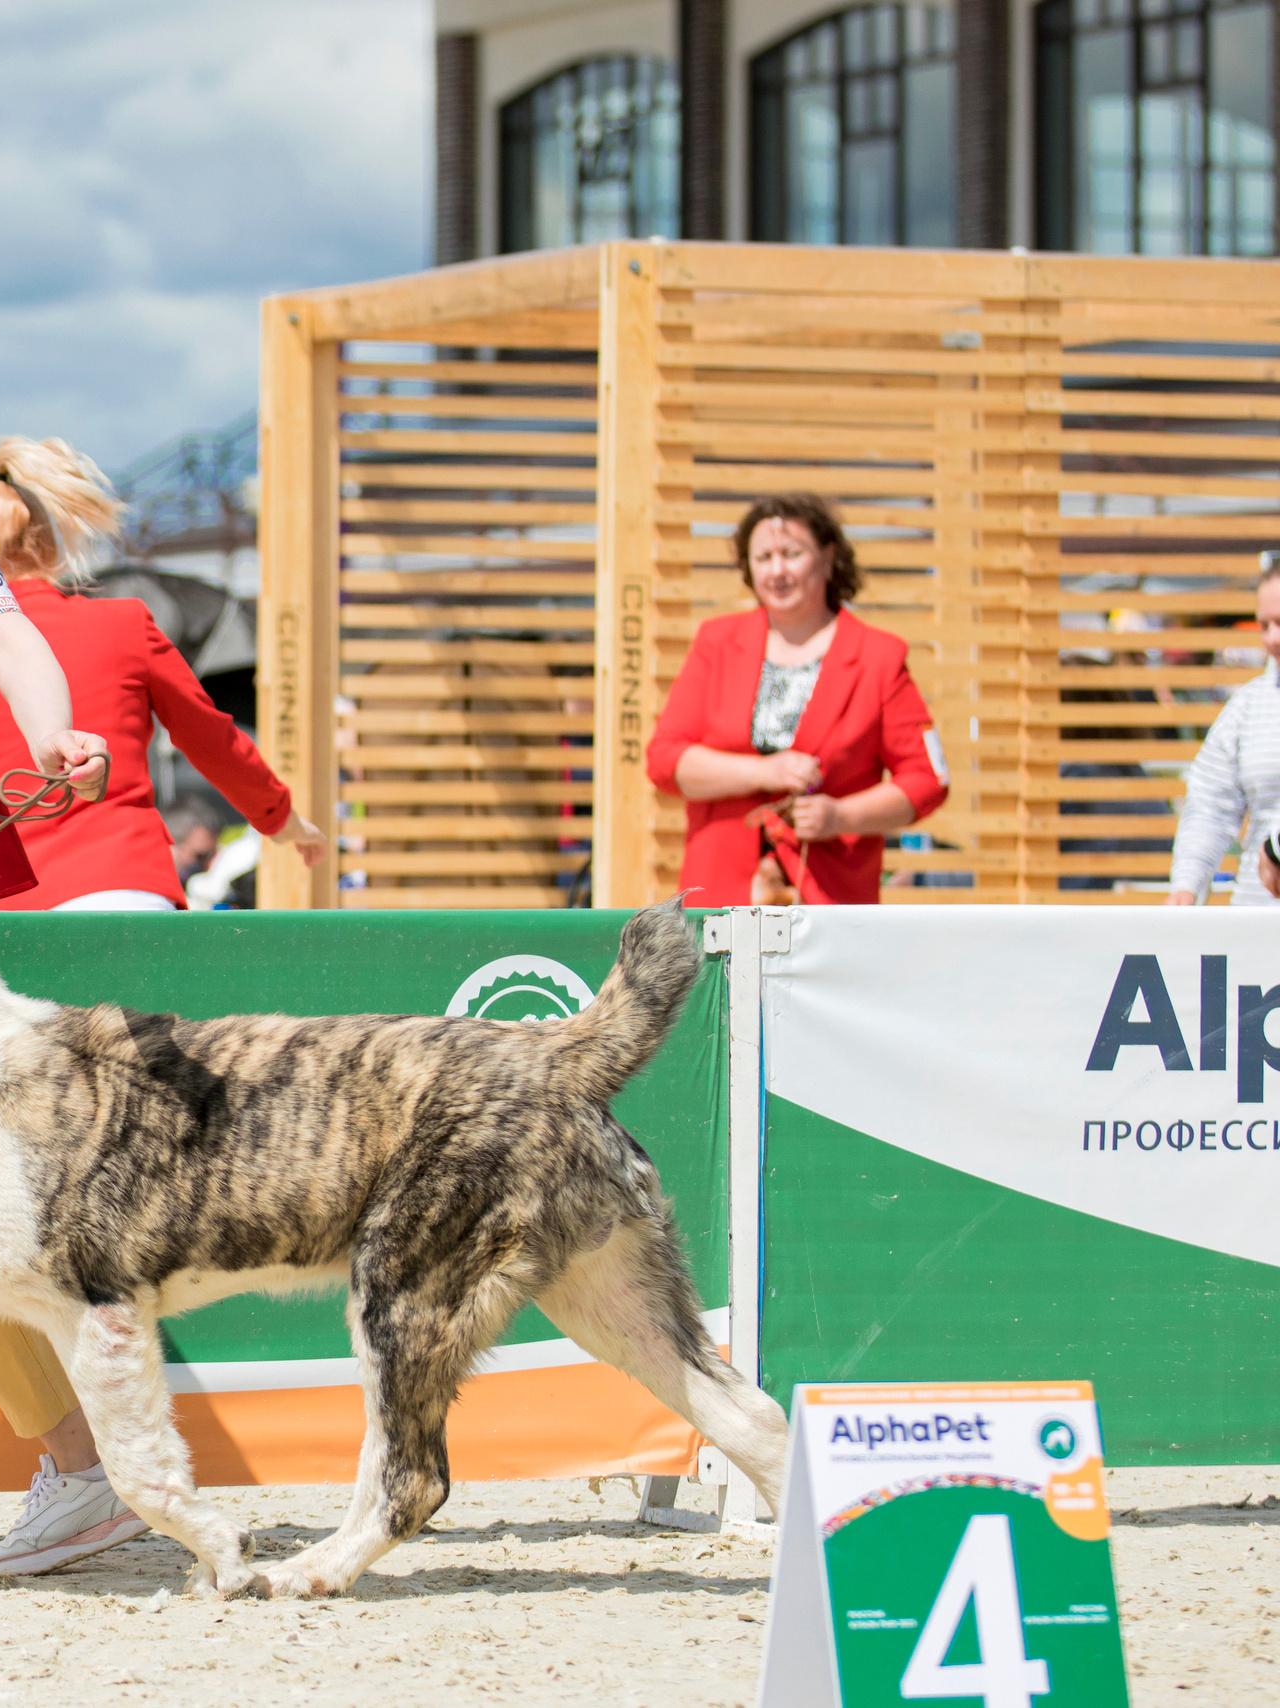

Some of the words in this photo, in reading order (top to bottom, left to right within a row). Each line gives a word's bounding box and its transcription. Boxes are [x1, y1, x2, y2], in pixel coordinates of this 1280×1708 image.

[622, 584, 643, 764] CORNER
[831, 1413, 991, 1450] AlphaPet
[899, 1512, 1051, 1708] 4
